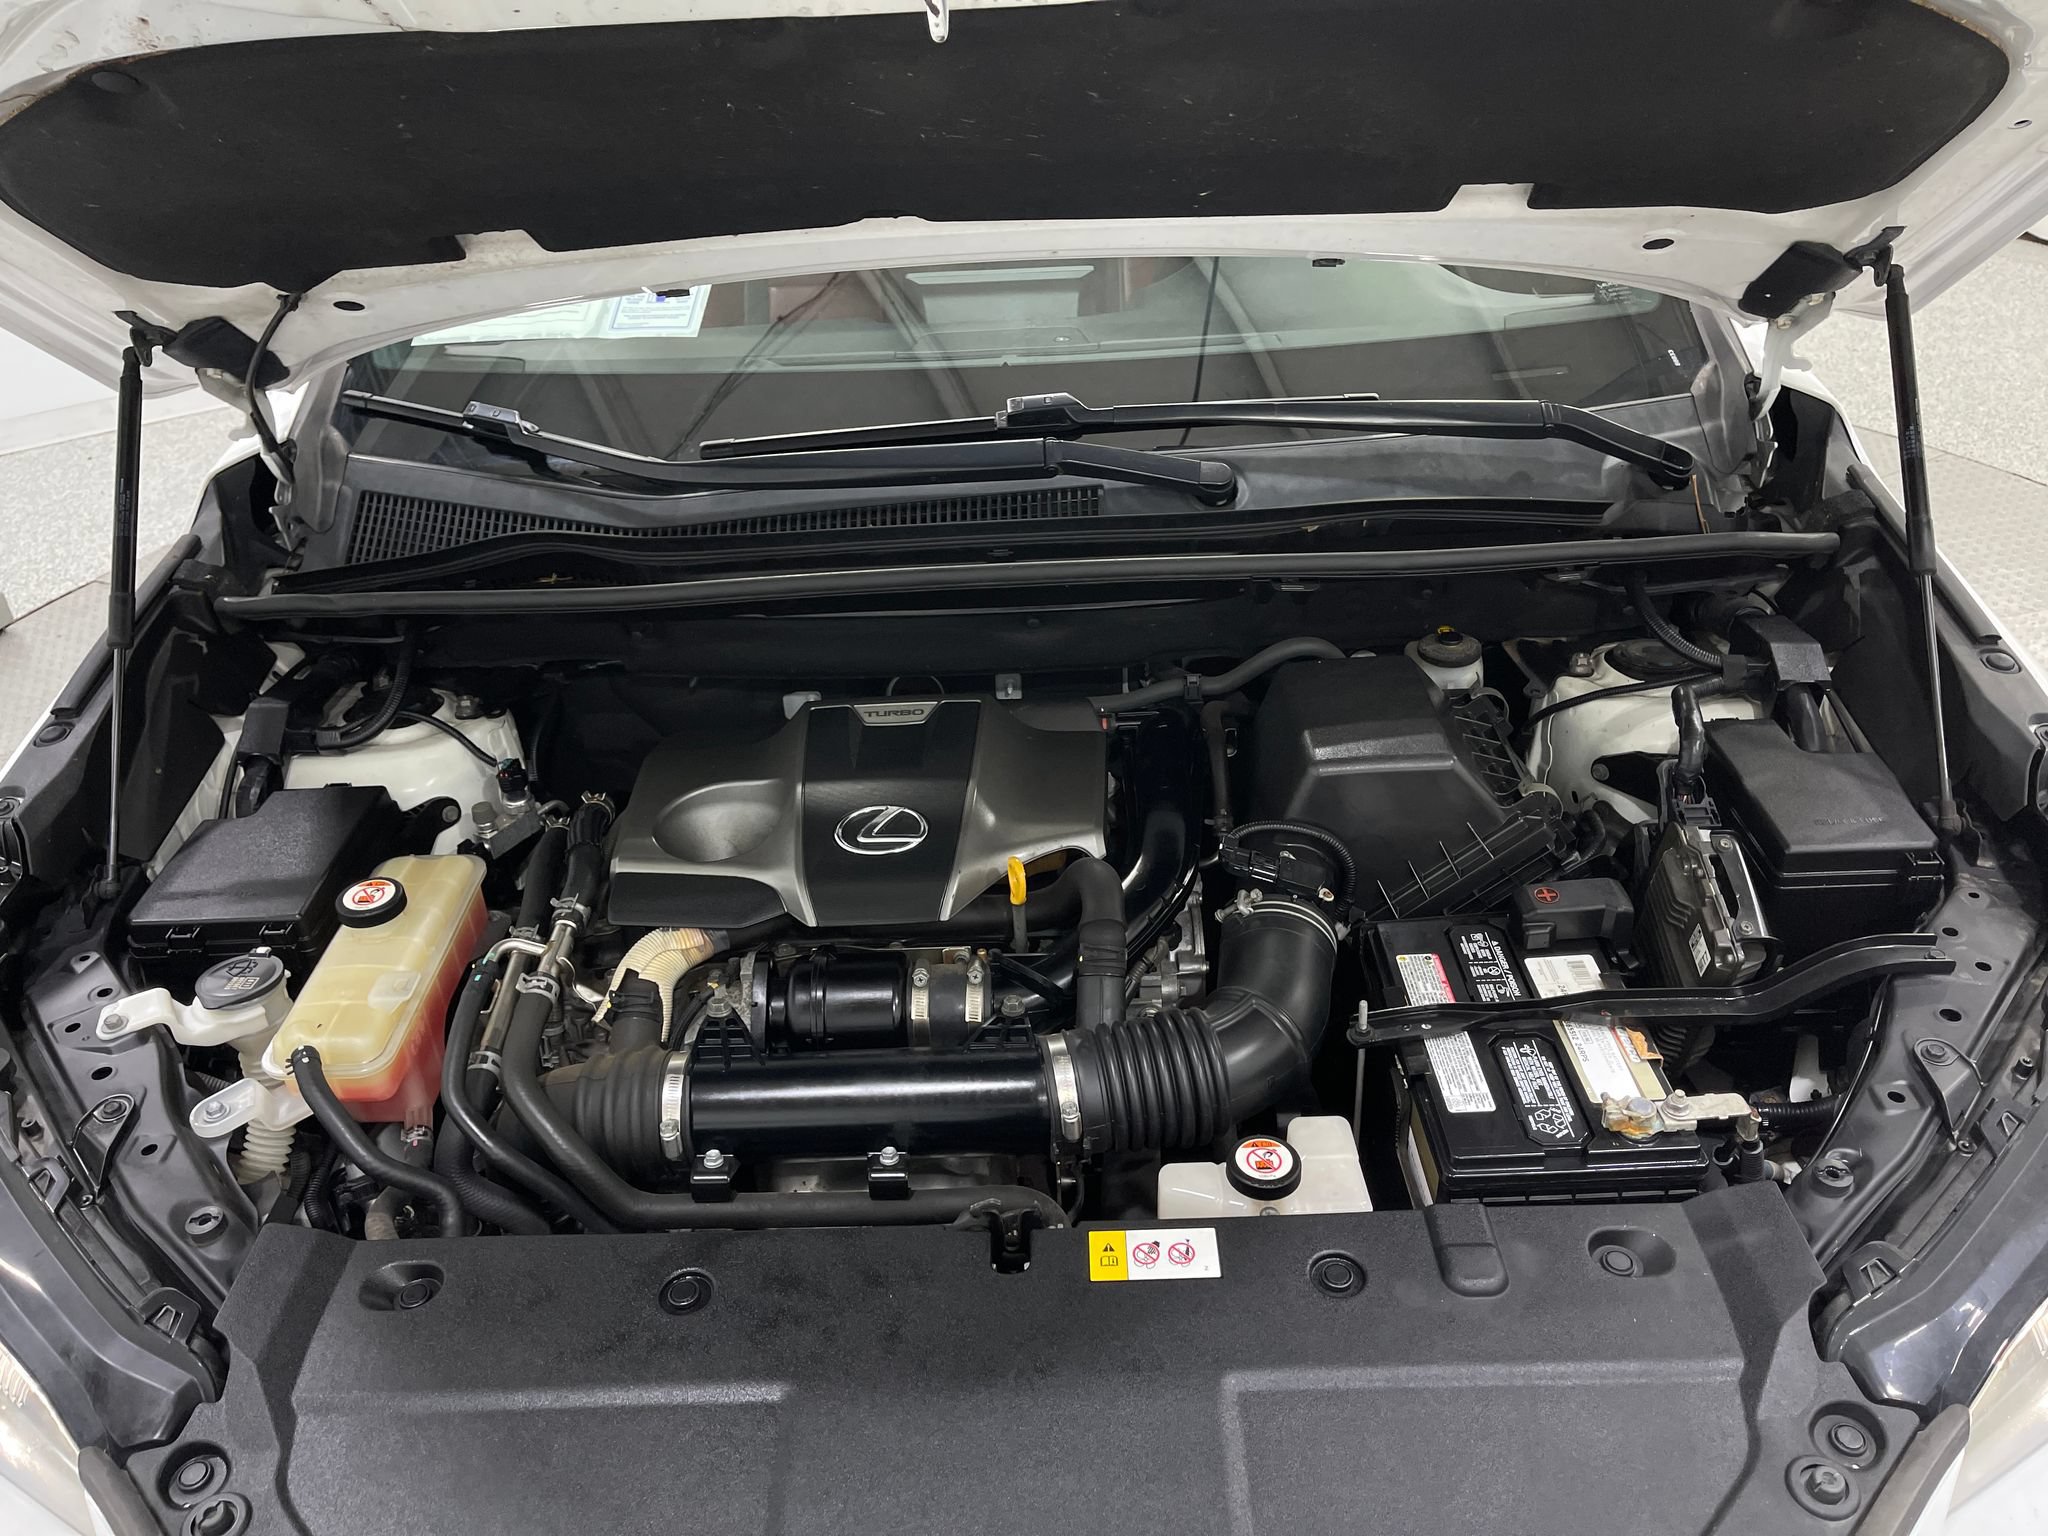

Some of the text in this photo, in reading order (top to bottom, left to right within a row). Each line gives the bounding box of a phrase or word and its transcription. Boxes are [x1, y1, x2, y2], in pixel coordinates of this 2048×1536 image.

[864, 709, 925, 717] TURBO
[1494, 946, 1510, 970] DANGER
[1505, 974, 1522, 997] POISON
